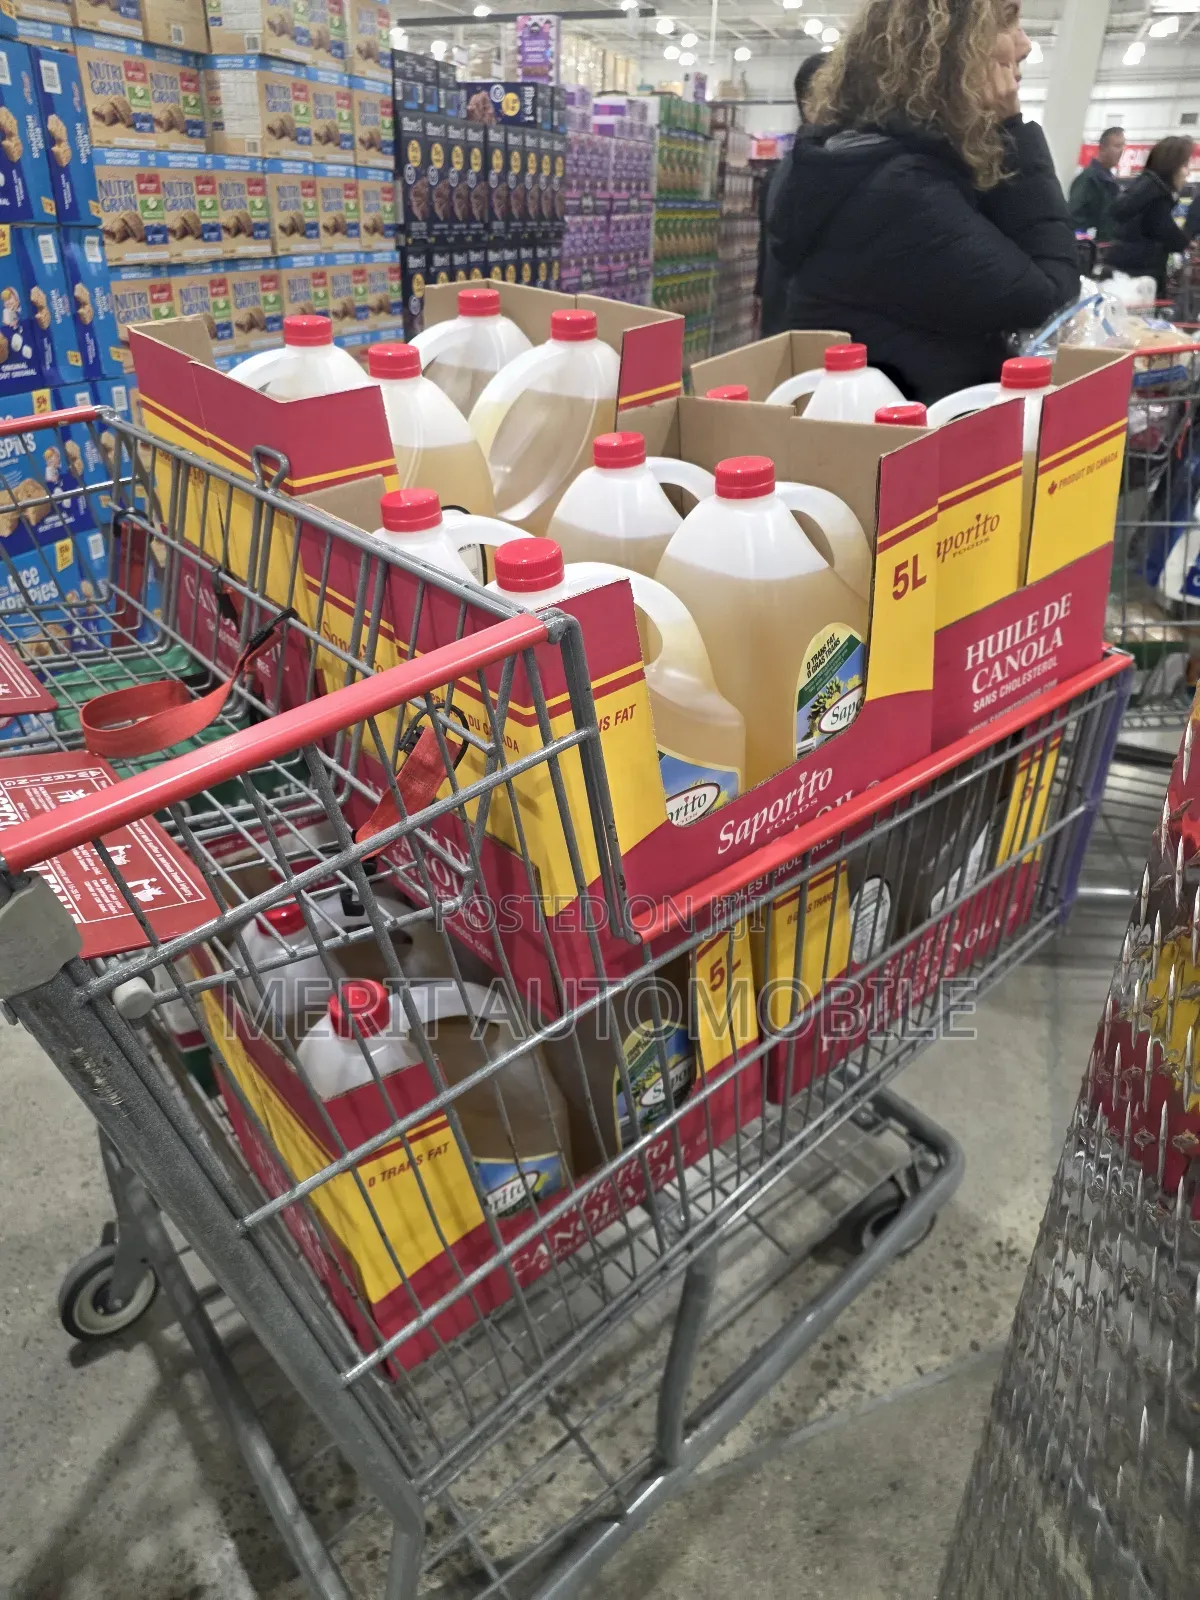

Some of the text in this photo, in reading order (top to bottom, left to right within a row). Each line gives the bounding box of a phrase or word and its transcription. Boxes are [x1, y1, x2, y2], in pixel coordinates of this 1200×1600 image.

[892, 554, 927, 600] 5L
[811, 644, 826, 666] TRANS
[826, 633, 836, 648] FAT
[964, 592, 1072, 671] HUILE DE
[812, 655, 826, 674] GRAS
[826, 637, 840, 658] TRANS
[972, 626, 1064, 694] CANOLA
[614, 704, 636, 726] FAT
[973, 690, 998, 713] SANS
[468, 714, 480, 730] DU
[2, 770, 90, 787] WARNING
[718, 768, 833, 855] Saporito
[766, 798, 818, 834] FOODS
[368, 1176, 376, 1188] 0
[428, 1141, 450, 1162] FAT
